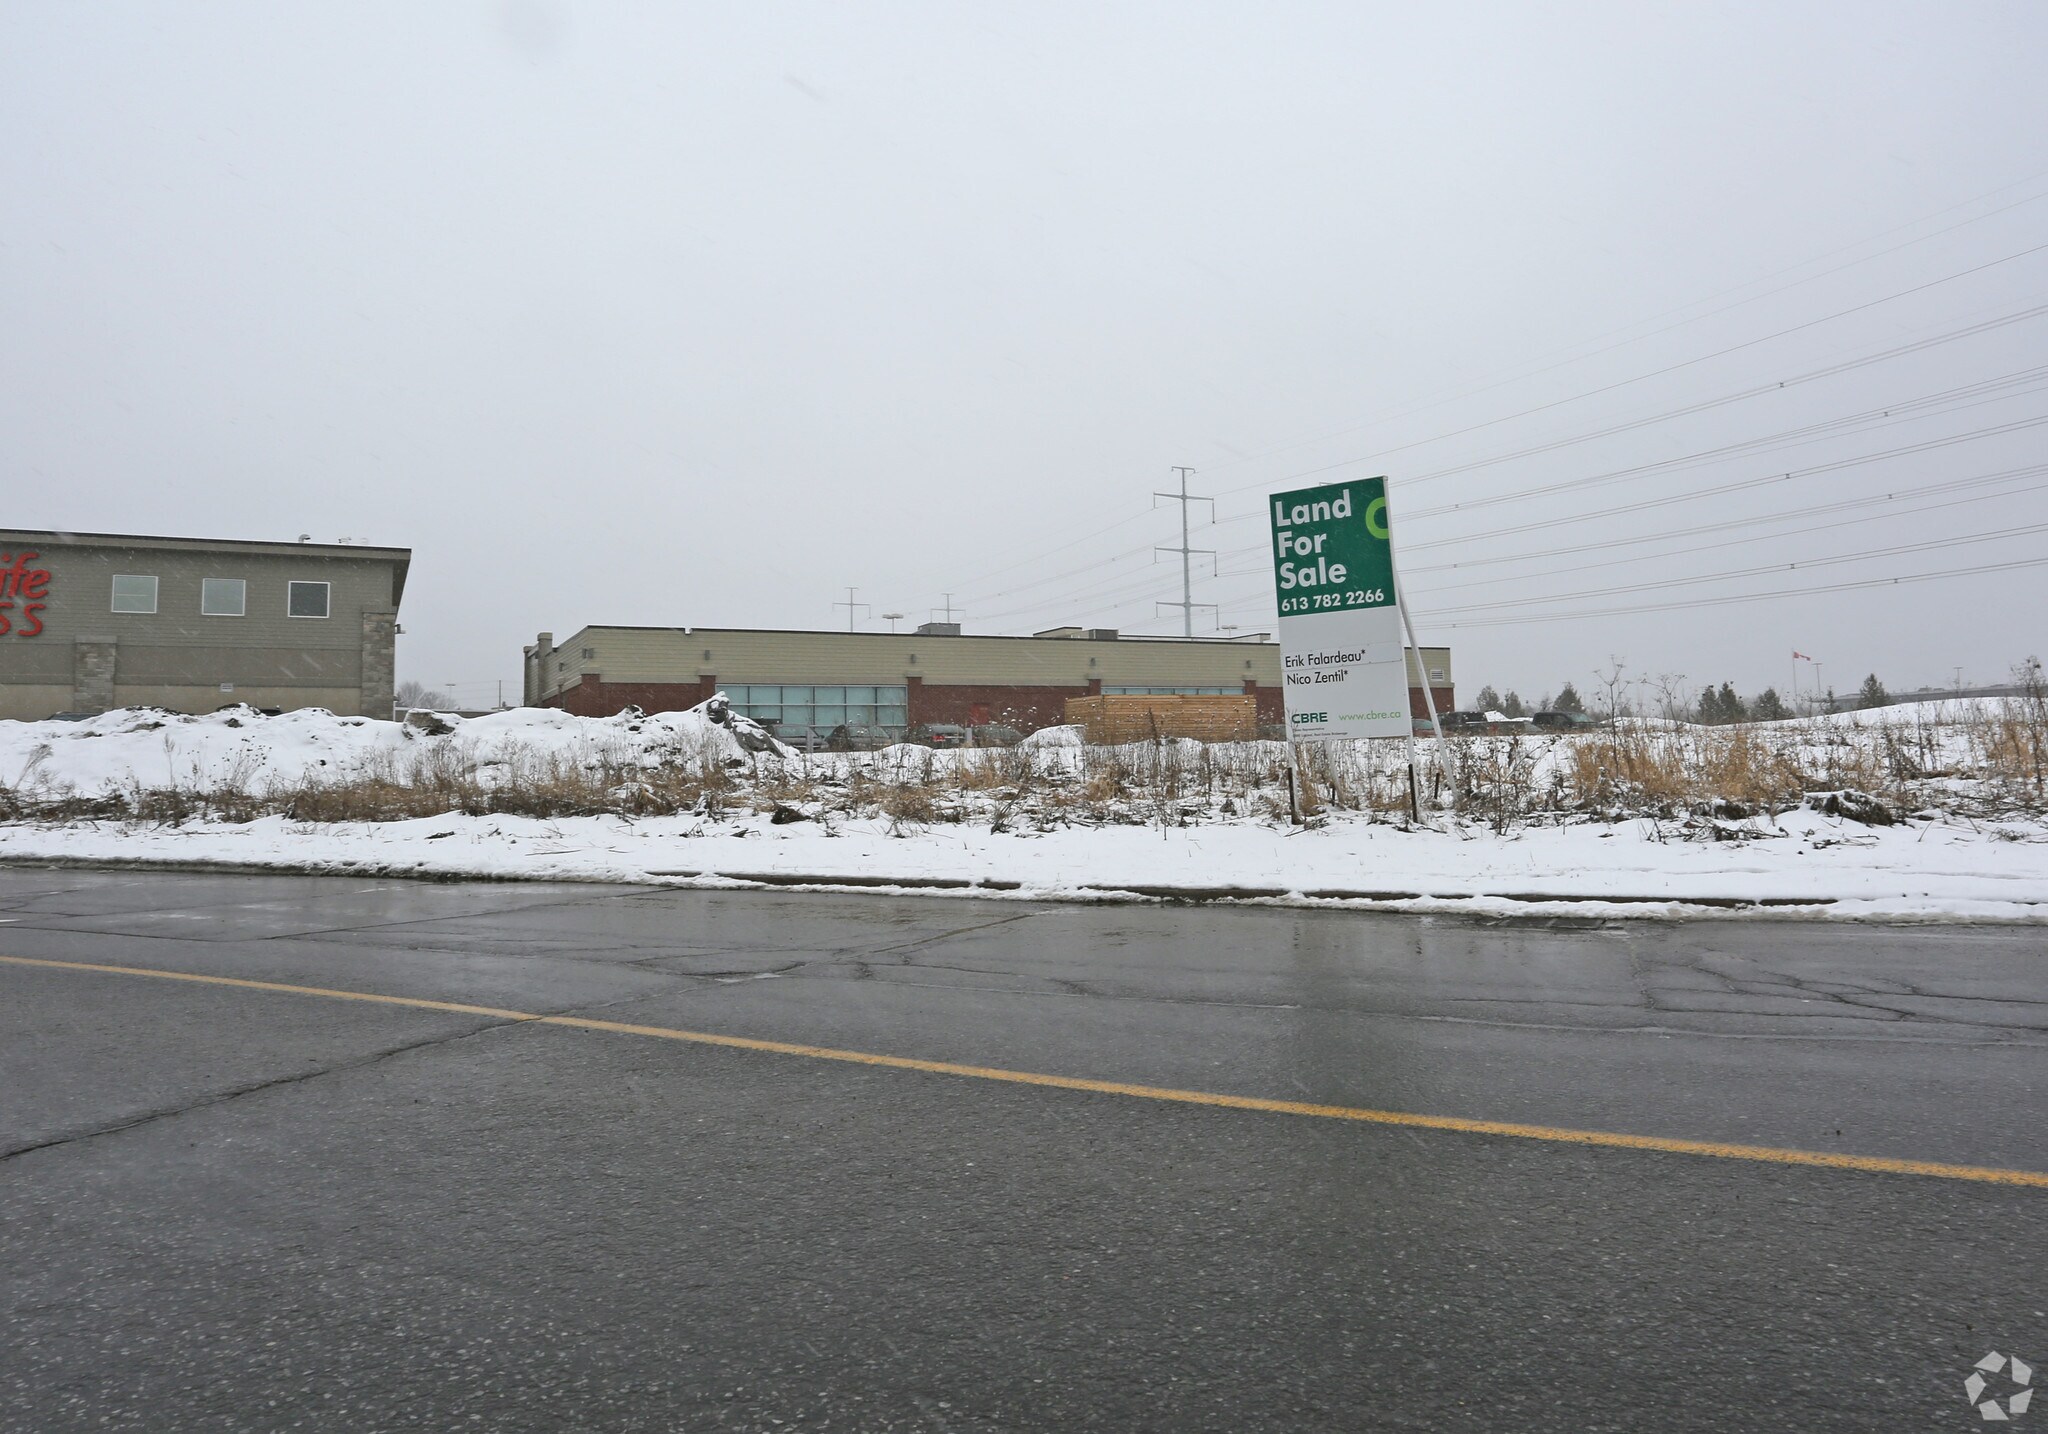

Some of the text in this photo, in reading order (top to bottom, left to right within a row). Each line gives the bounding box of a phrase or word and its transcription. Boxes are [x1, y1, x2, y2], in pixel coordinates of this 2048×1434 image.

[1275, 489, 1352, 527] Land
[1277, 531, 1327, 558] For
[1280, 556, 1347, 590] Sale
[1281, 588, 1385, 612] 613 782 2266
[1285, 654, 1305, 668] Erik
[1286, 673, 1311, 685] Nico
[1291, 712, 1328, 724] CBRE
[1338, 710, 1401, 721] www.cbre.ca
